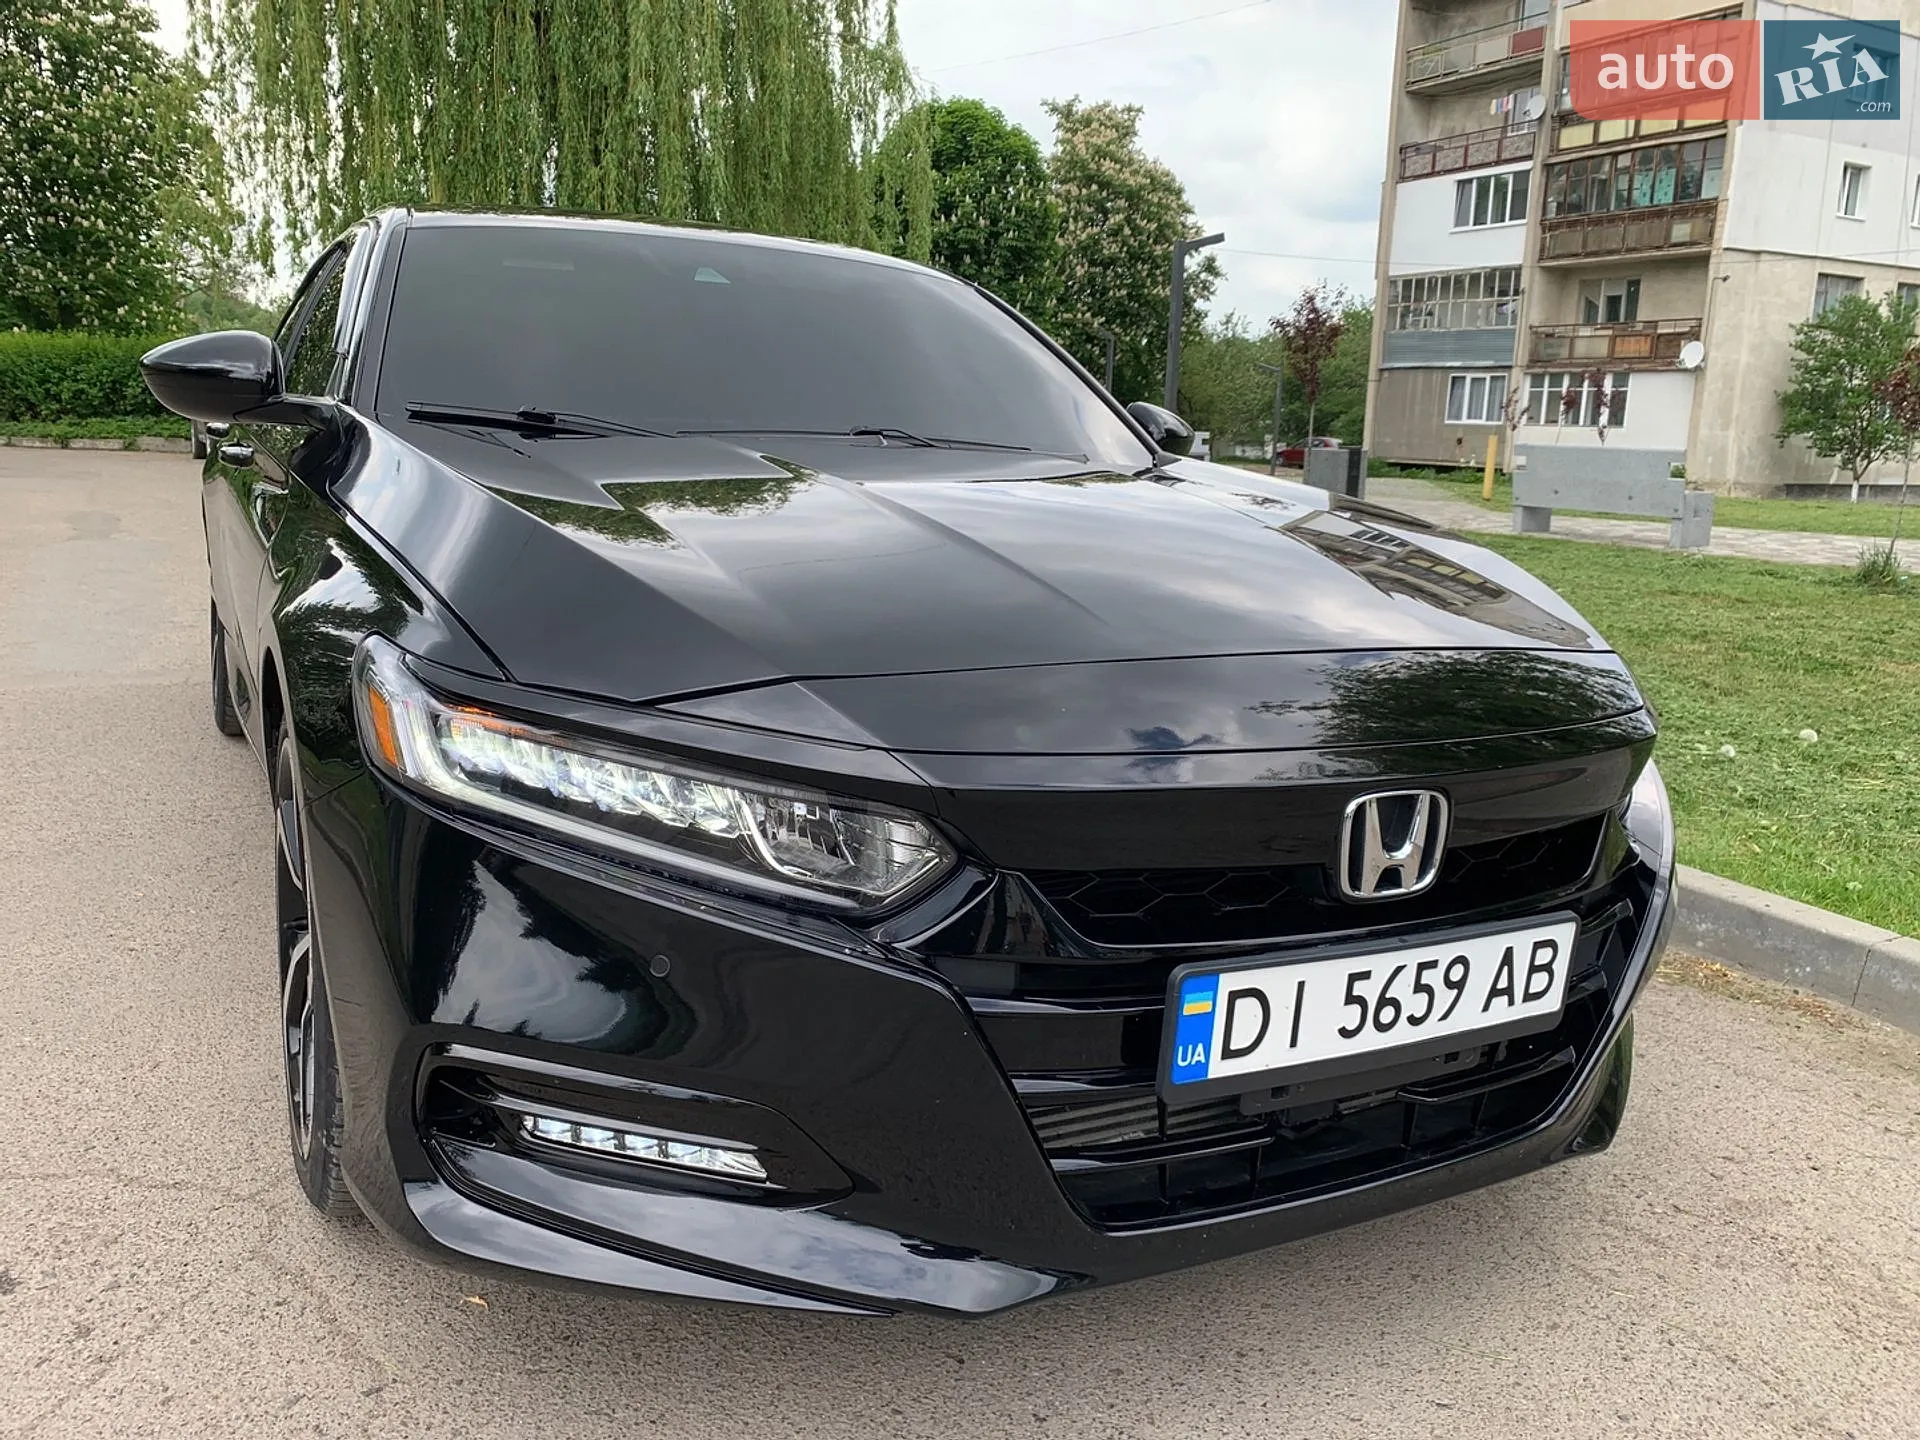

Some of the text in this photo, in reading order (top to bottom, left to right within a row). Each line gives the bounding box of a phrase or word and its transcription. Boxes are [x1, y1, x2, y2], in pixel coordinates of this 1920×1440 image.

[1220, 938, 1559, 1061] DI 5659 AB
[1177, 1042, 1207, 1068] UA
